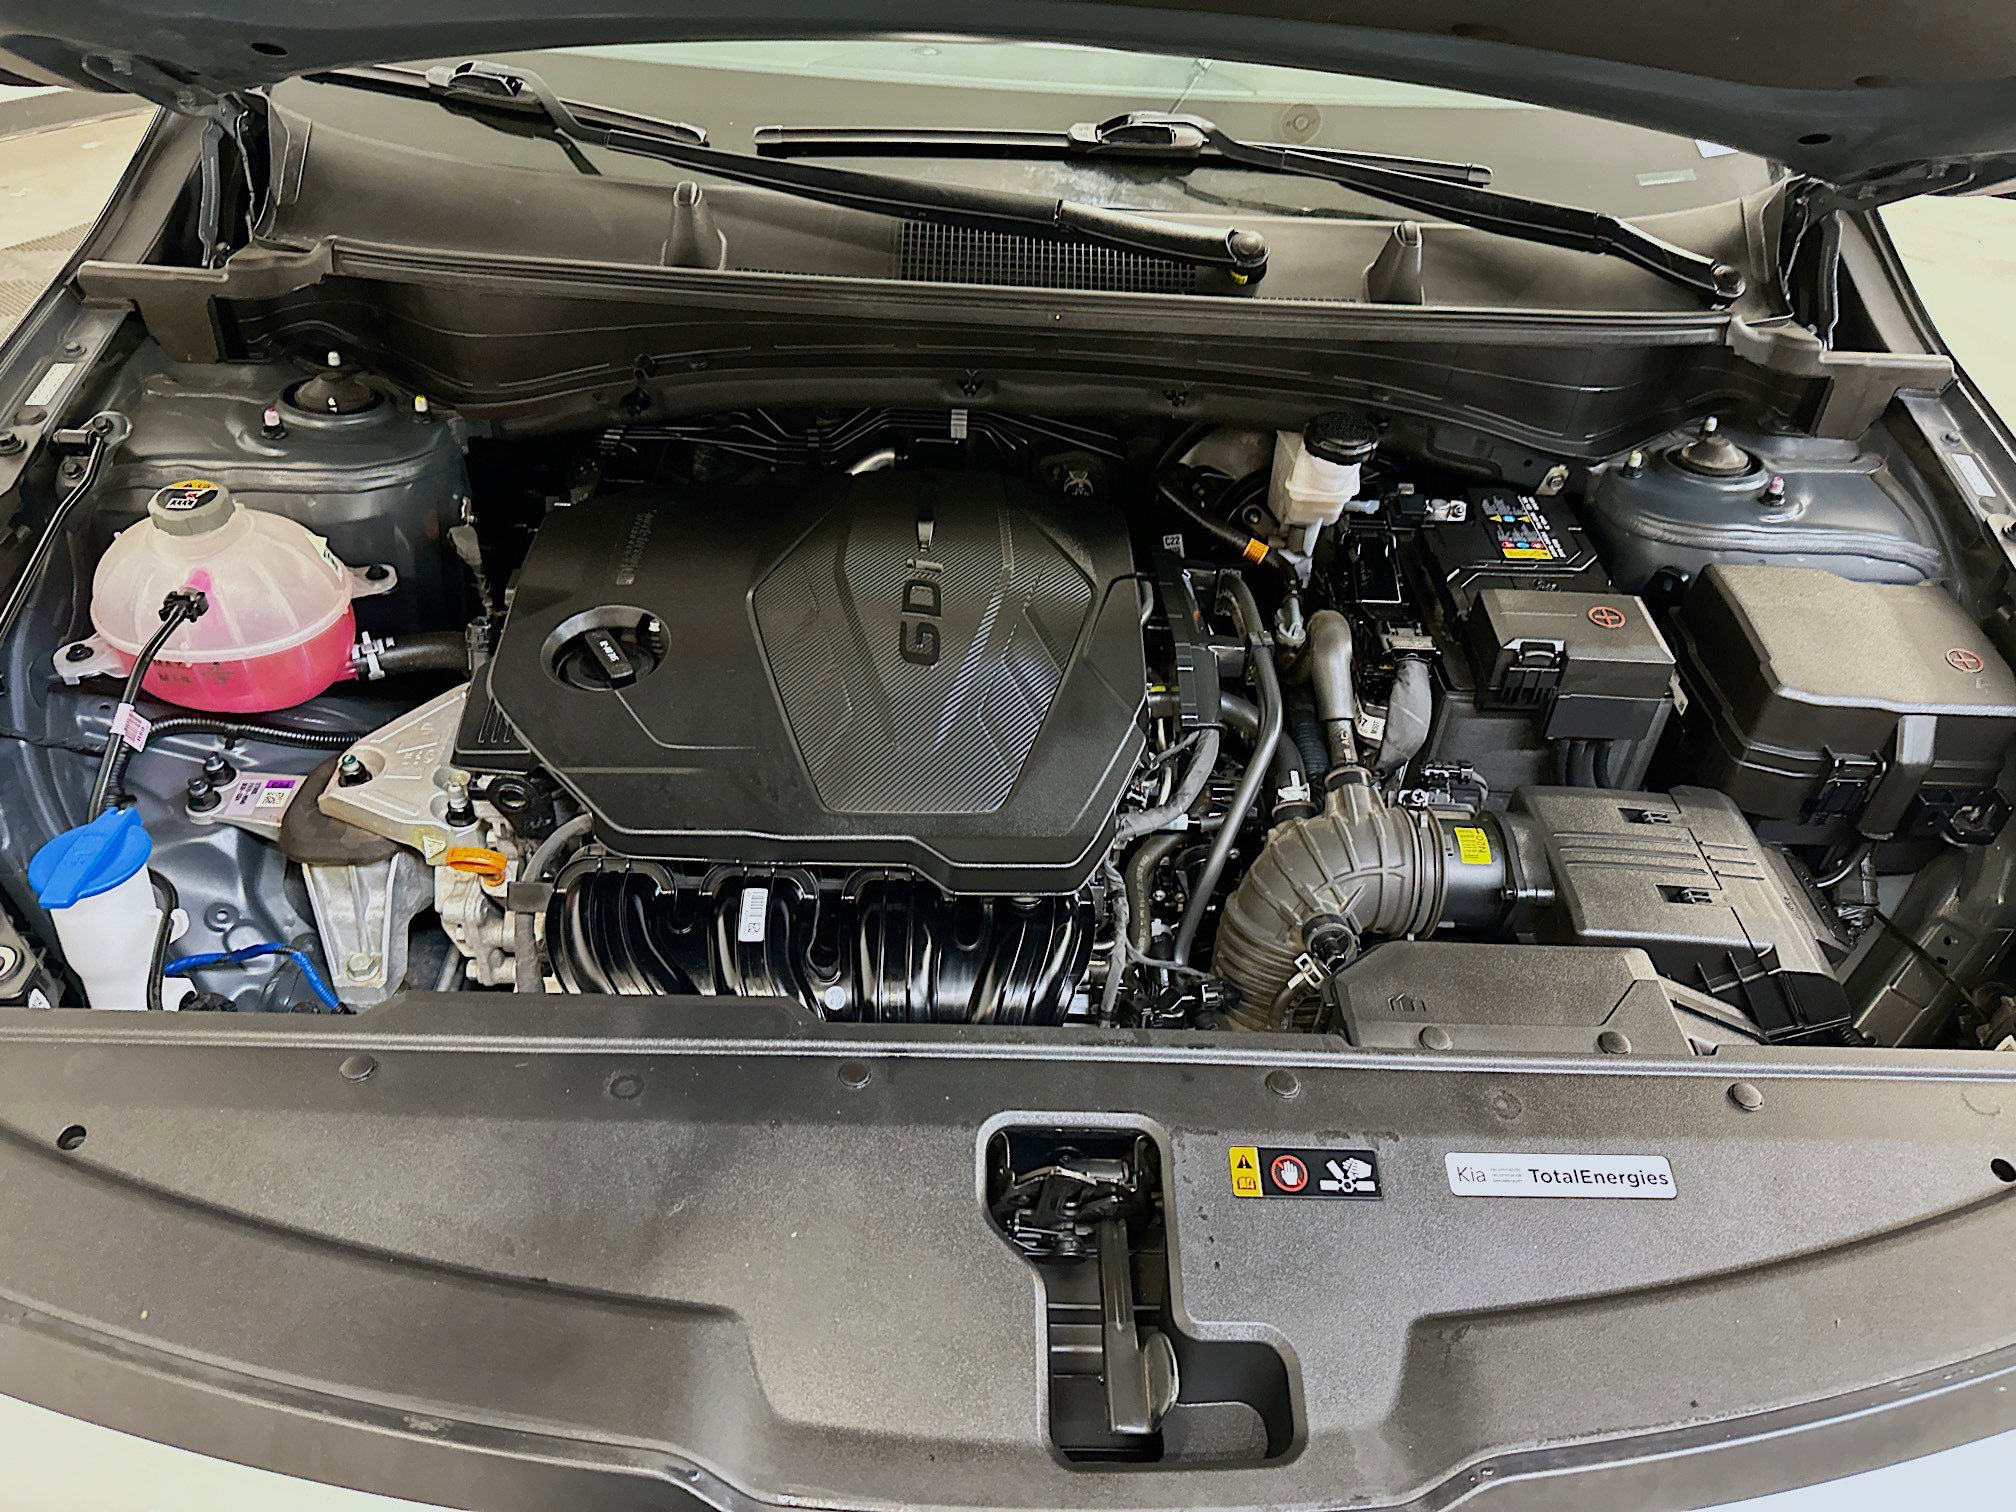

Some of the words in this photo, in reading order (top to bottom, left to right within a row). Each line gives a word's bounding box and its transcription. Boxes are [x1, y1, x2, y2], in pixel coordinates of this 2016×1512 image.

[899, 557, 944, 669] GDi
[1456, 1166, 1486, 1183] Kia
[1528, 1168, 1669, 1188] TotalEnergies
